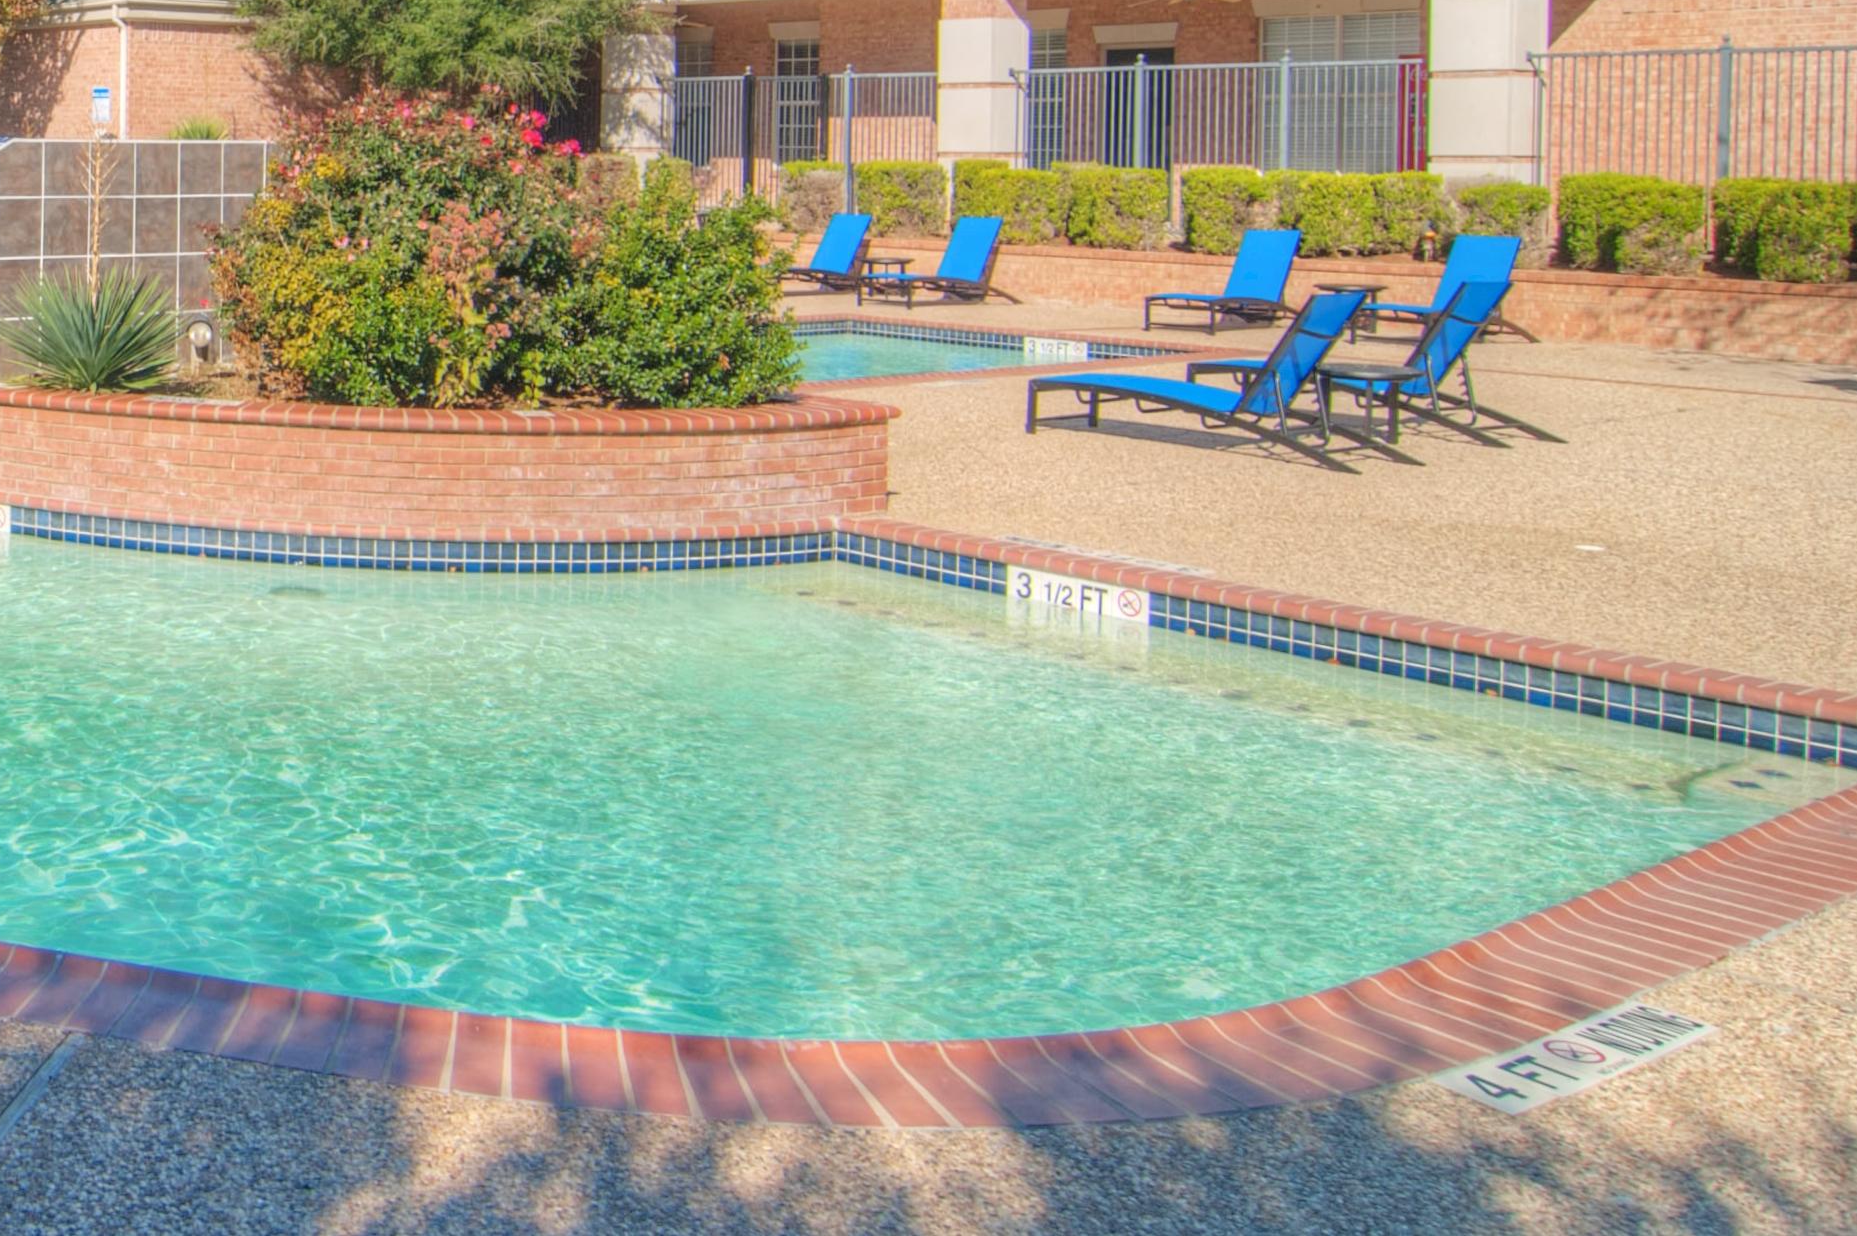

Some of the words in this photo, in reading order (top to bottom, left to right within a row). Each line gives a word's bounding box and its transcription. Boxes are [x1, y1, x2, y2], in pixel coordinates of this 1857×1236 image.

[1056, 341, 1070, 357] FT
[1016, 572, 1032, 598] 3
[1044, 581, 1073, 606] 1/2
[1079, 585, 1108, 615] FT
[1574, 1026, 1652, 1057] NO
[1597, 1005, 1704, 1046] DIVING
[1466, 1073, 1528, 1099] 4
[1497, 1054, 1581, 1090] FT
